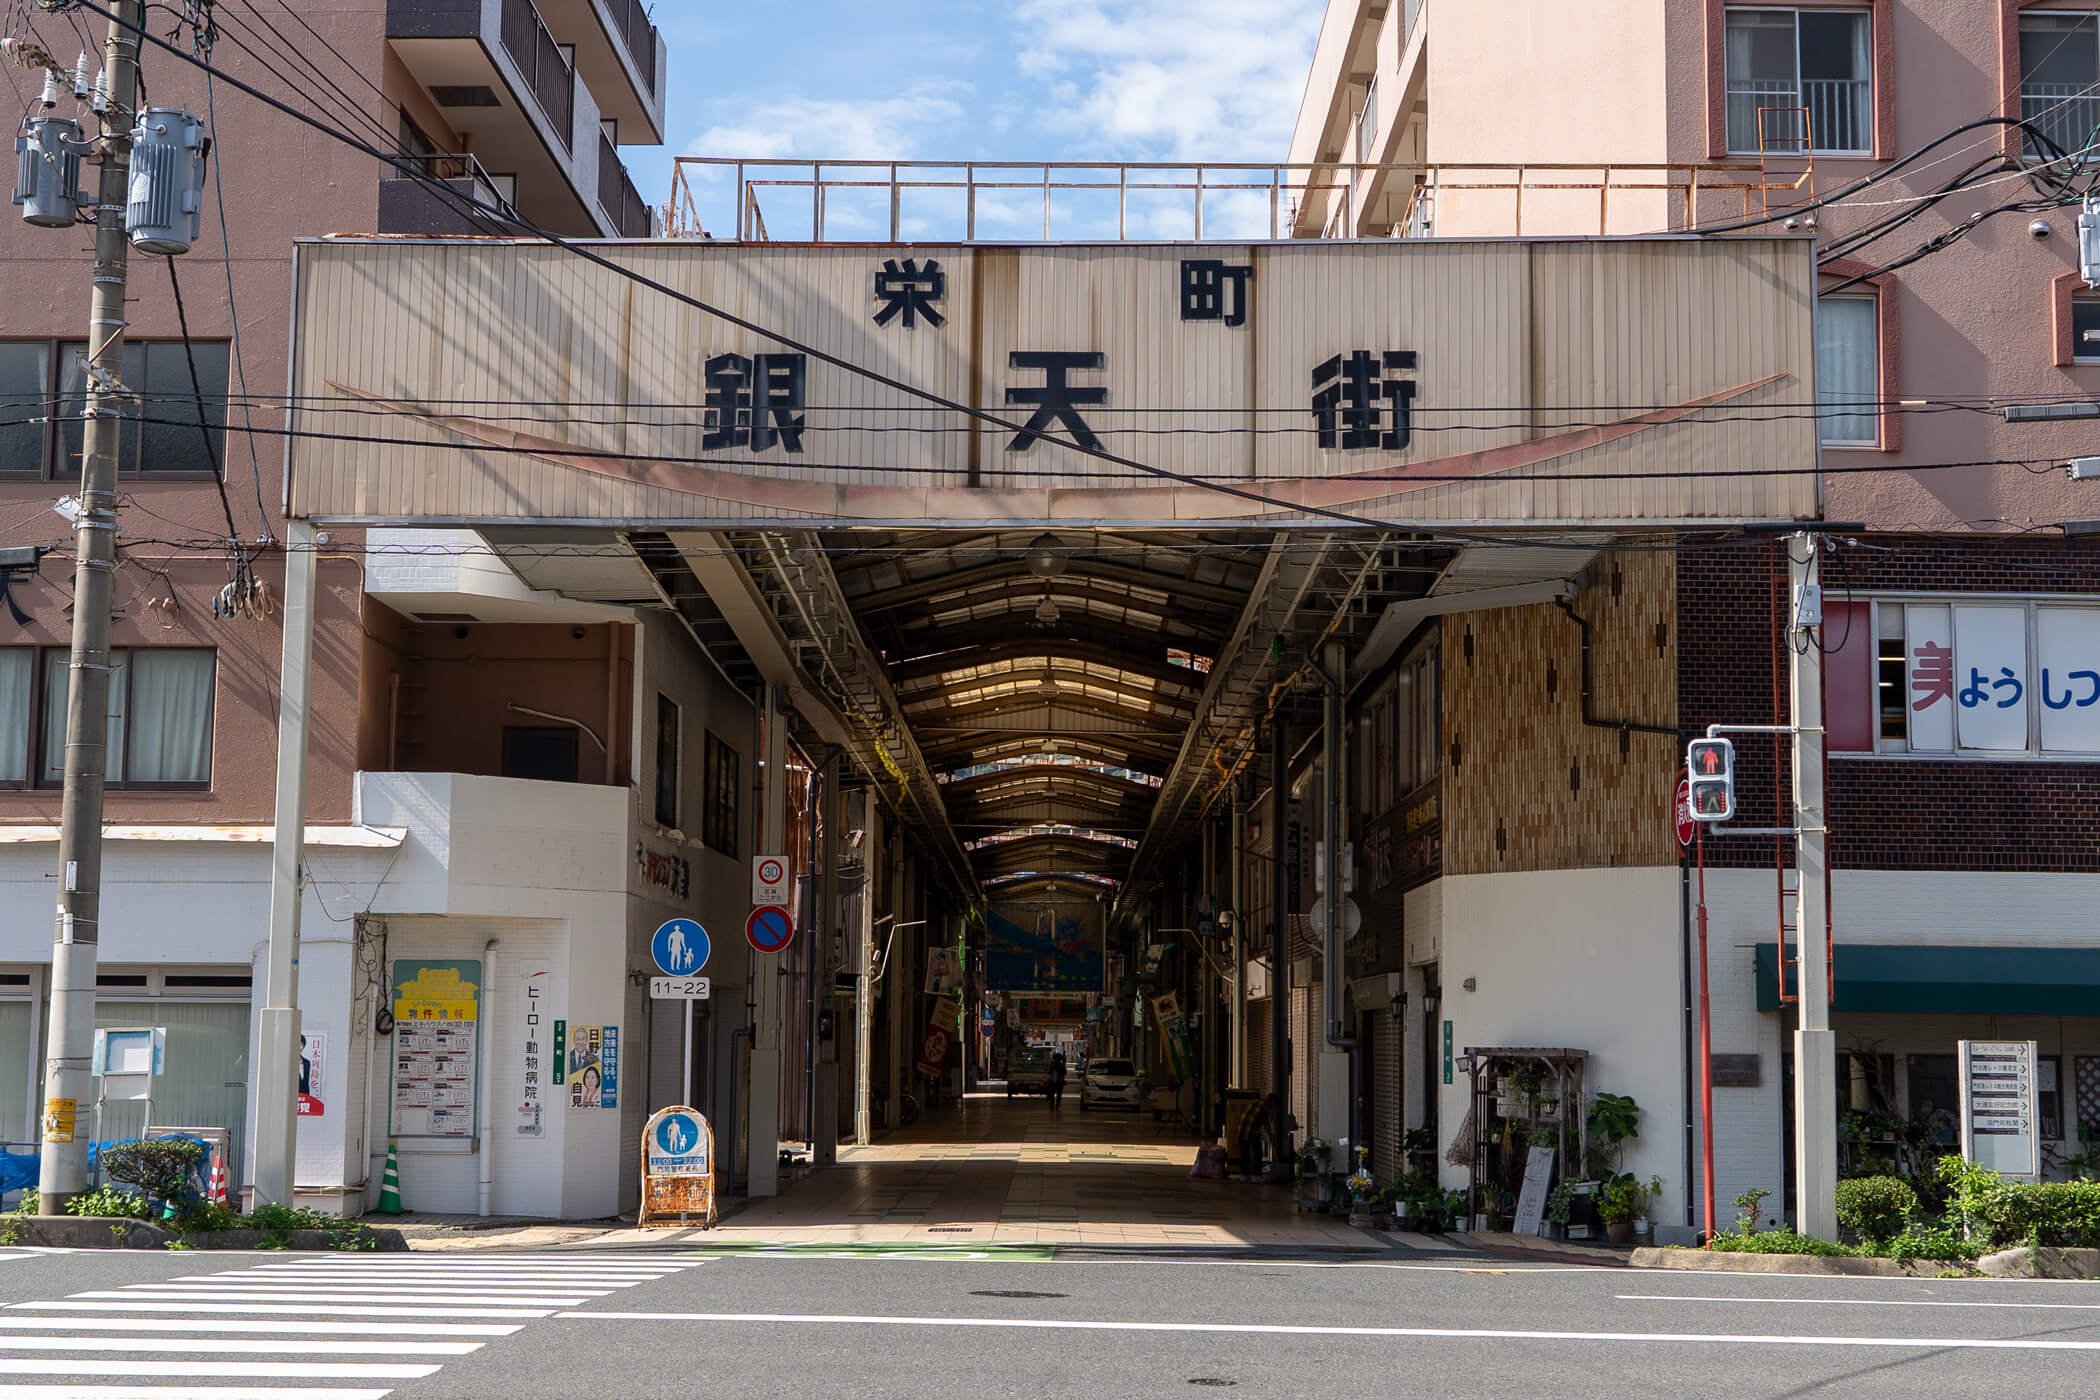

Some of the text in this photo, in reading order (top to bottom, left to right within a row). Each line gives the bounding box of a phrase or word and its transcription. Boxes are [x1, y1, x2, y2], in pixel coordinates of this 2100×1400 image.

[702, 350, 1418, 454] 銀天街
[763, 866, 779, 878] 30
[654, 982, 707, 995] 11-22
[525, 985, 540, 1099] ヒーロー動物病院
[589, 1029, 601, 1054] 日野
[572, 1081, 582, 1108] 自見
